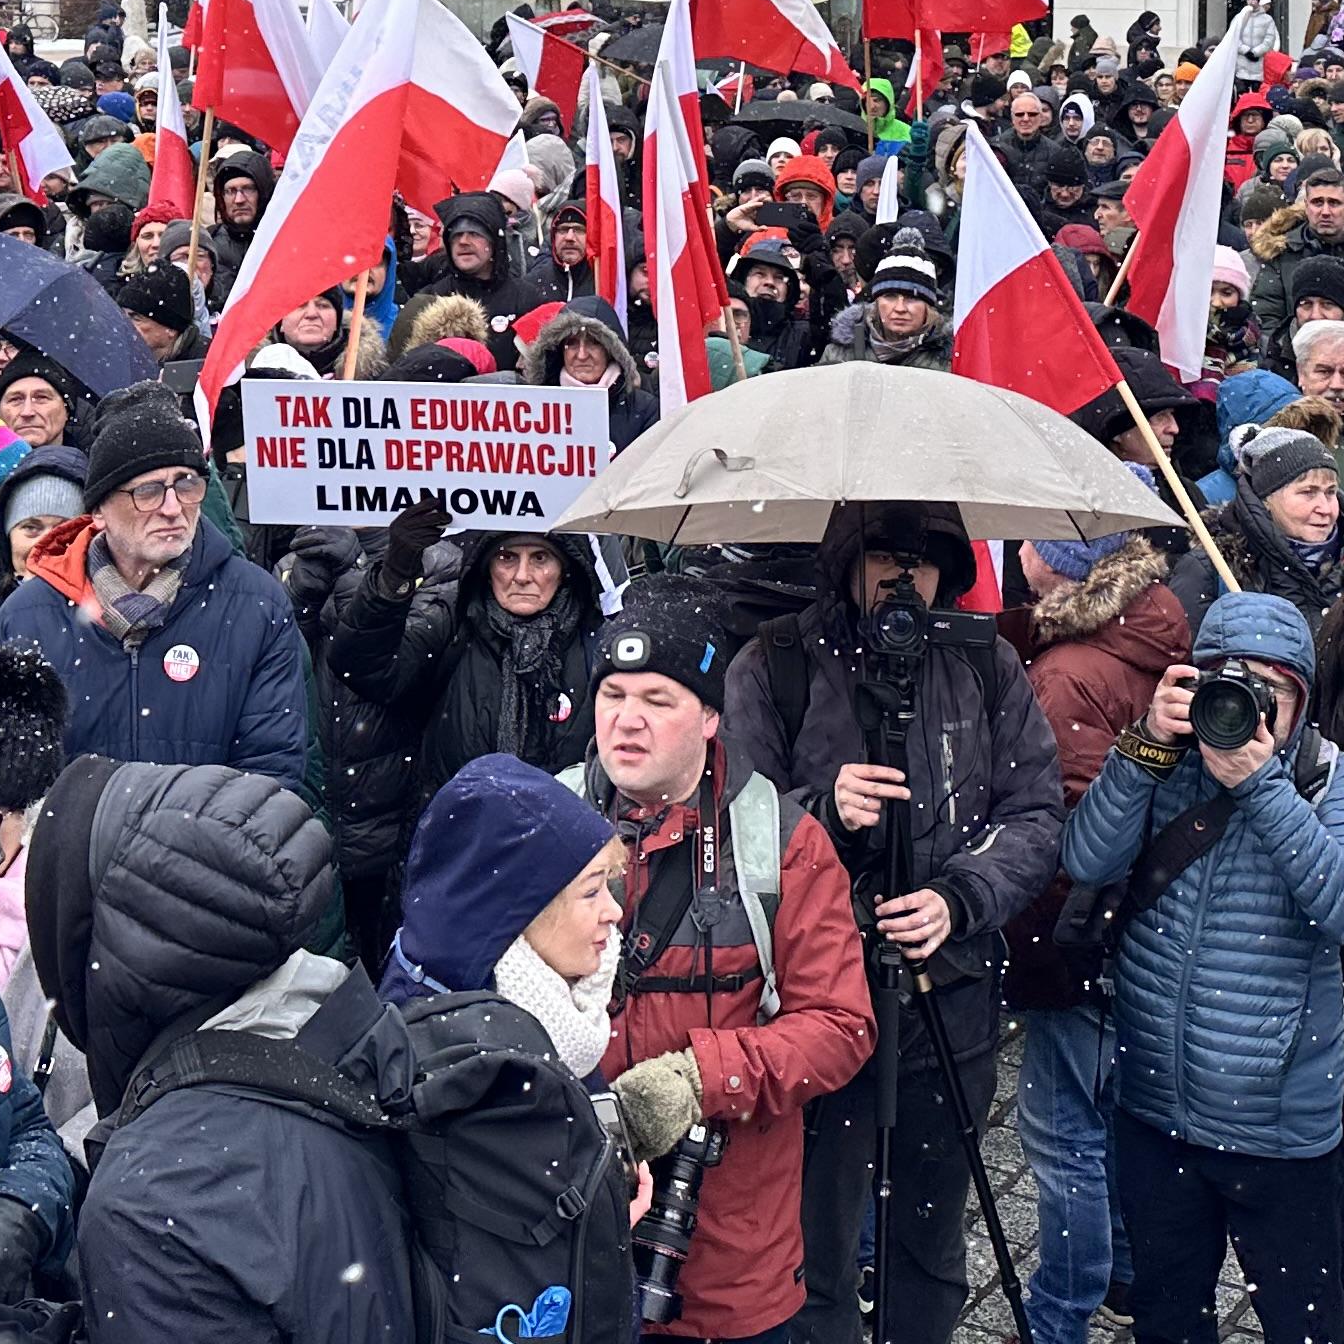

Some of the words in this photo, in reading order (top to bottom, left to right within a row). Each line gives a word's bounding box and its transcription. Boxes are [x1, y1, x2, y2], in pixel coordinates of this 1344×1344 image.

[274, 395, 333, 428] TAK
[342, 396, 401, 430] DLA
[410, 398, 573, 435] EDUKACJI!
[256, 436, 307, 469] NIE
[318, 437, 376, 470] DLA
[384, 438, 597, 478] DEPRAWACJI!
[703, 826, 714, 842] R6
[703, 843, 715, 873] EOS
